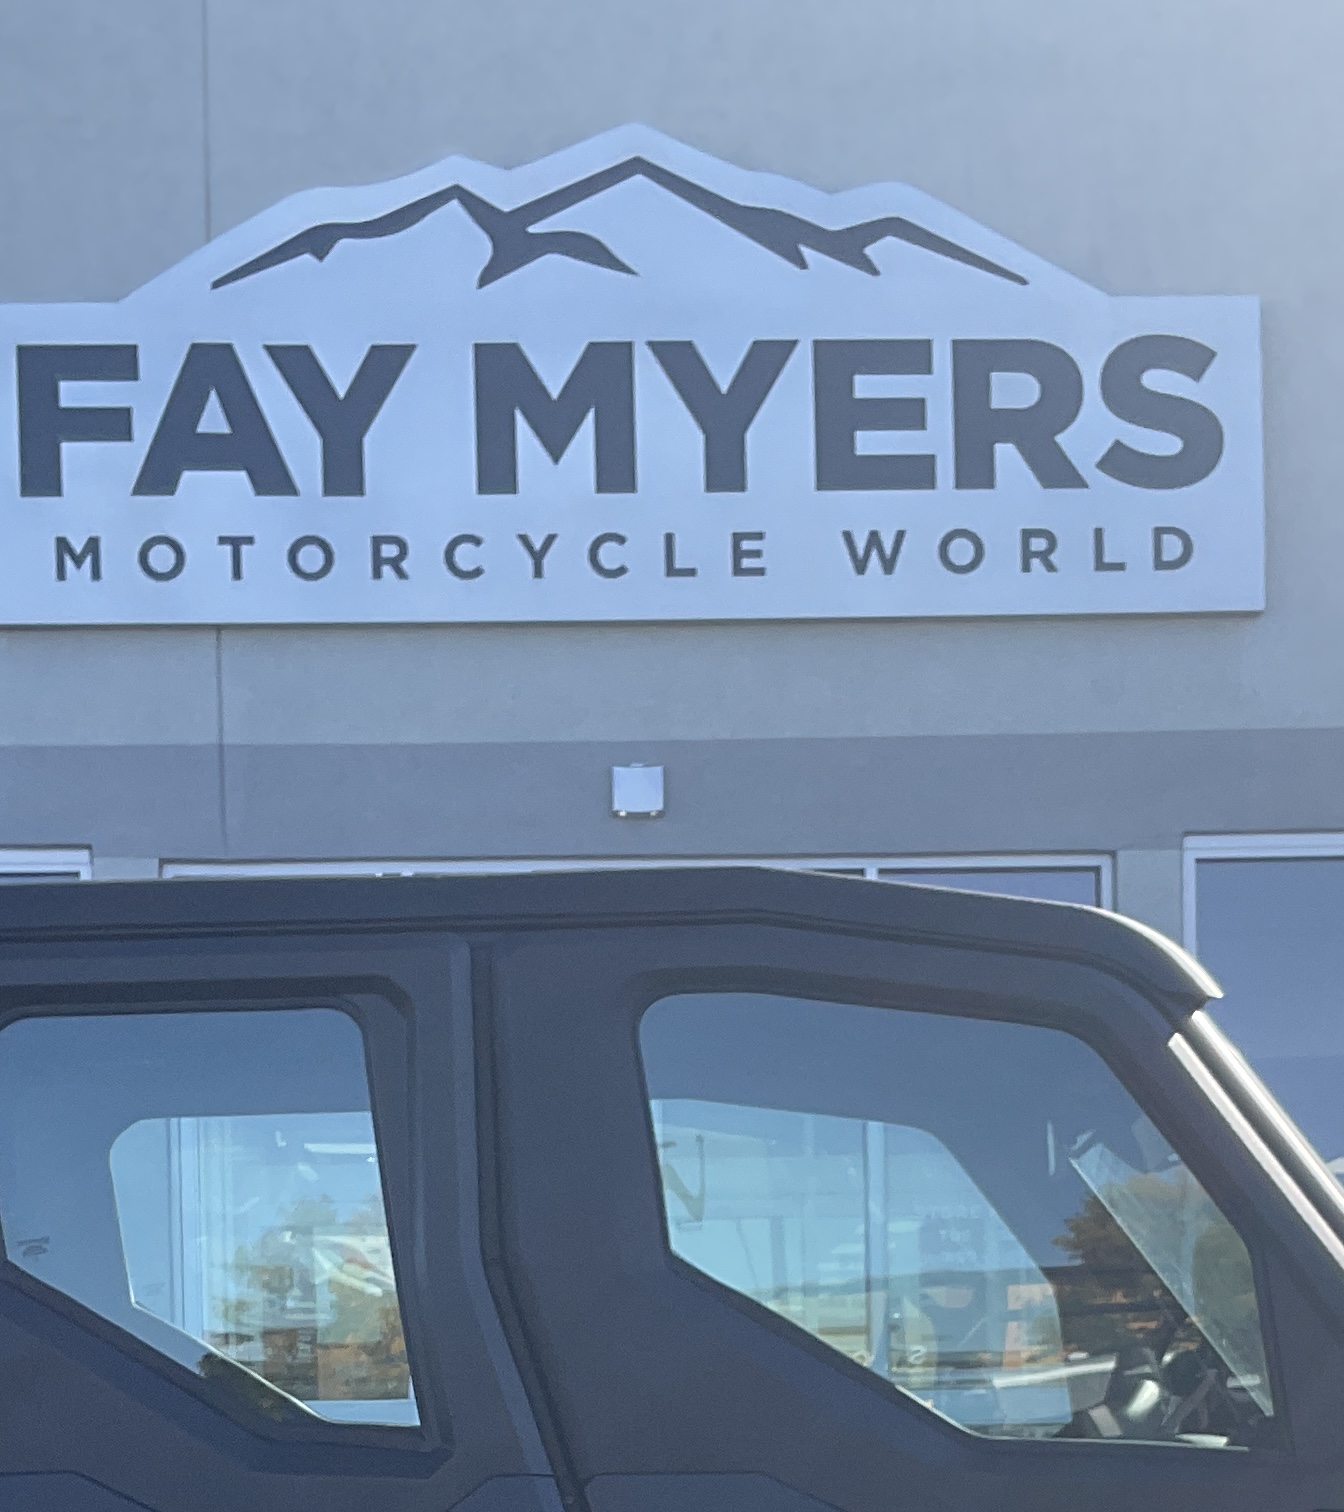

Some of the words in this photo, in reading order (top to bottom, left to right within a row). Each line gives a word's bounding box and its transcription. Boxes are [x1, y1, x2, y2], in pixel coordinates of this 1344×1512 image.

[16, 342, 417, 498] FAY
[472, 334, 1224, 496] MYERS
[55, 531, 767, 582] MOTORCYCLE
[841, 526, 1195, 576] WORLD
